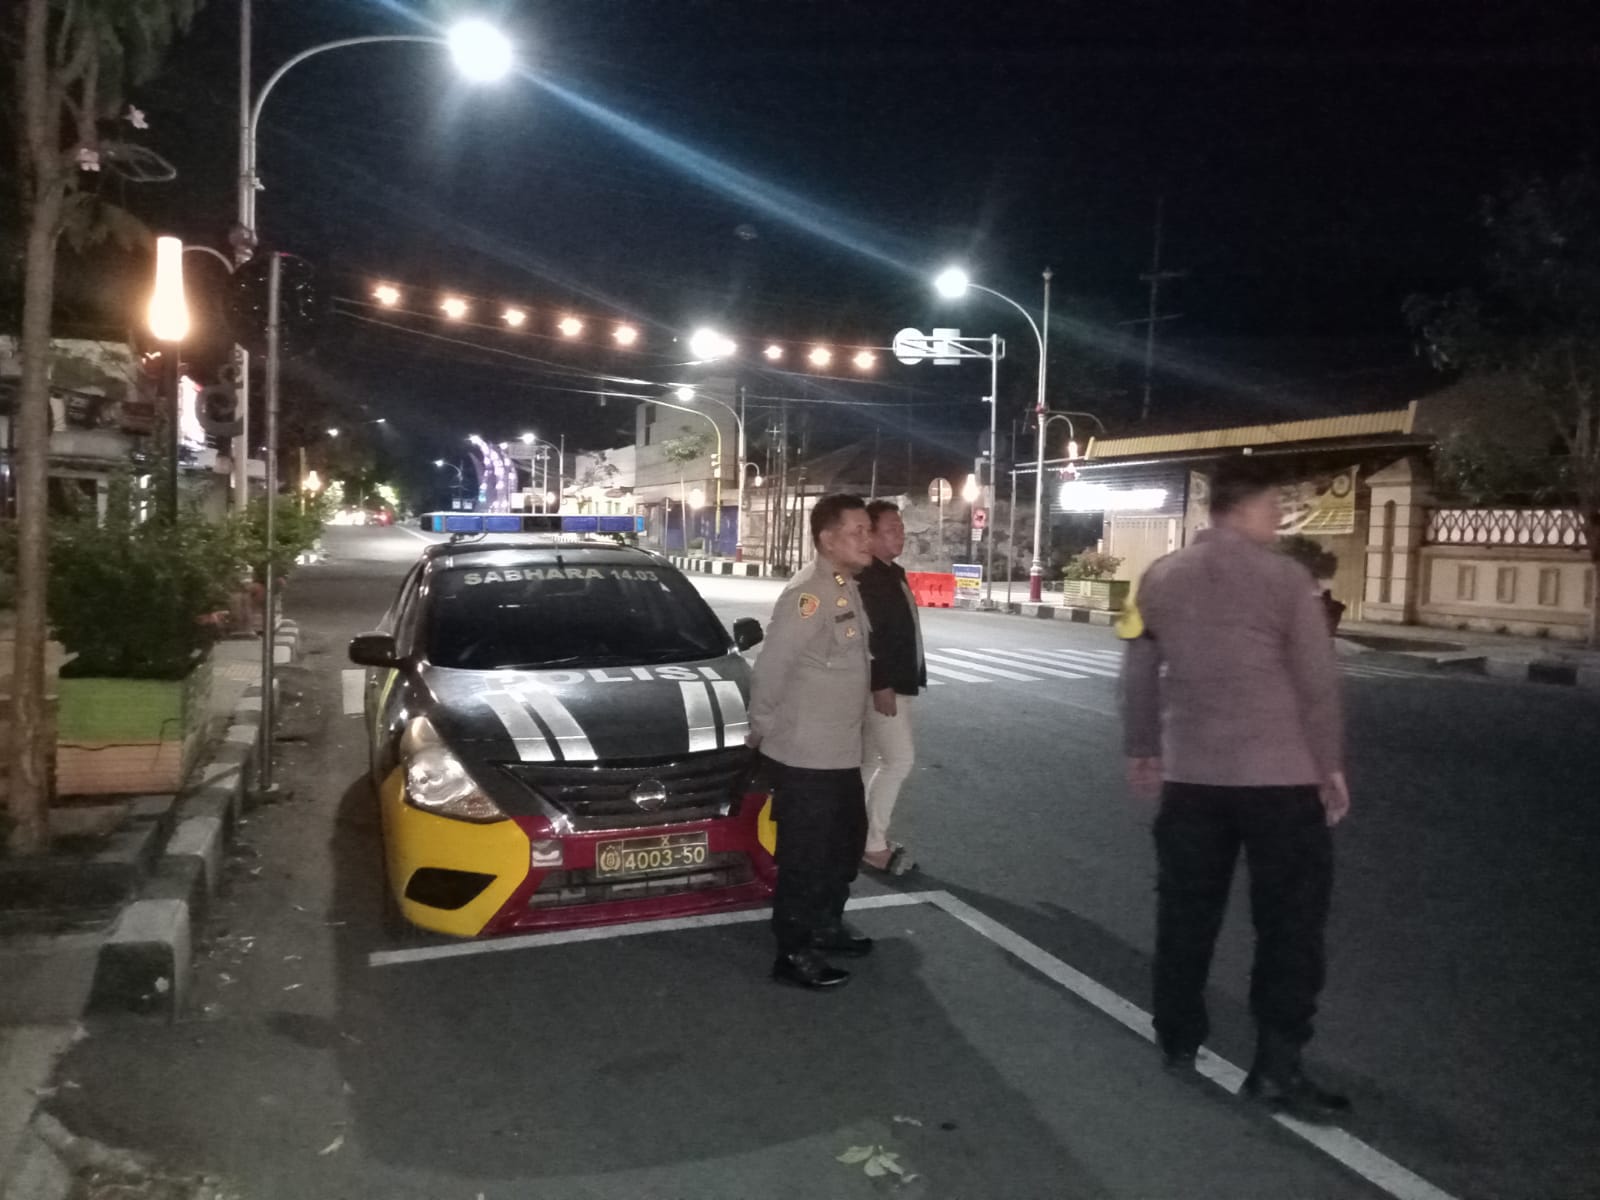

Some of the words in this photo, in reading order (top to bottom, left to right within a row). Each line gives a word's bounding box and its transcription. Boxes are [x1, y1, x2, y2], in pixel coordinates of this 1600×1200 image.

[463, 568, 604, 585] SABHARA
[483, 666, 723, 690] POLISI
[625, 846, 705, 870] 4003-50
